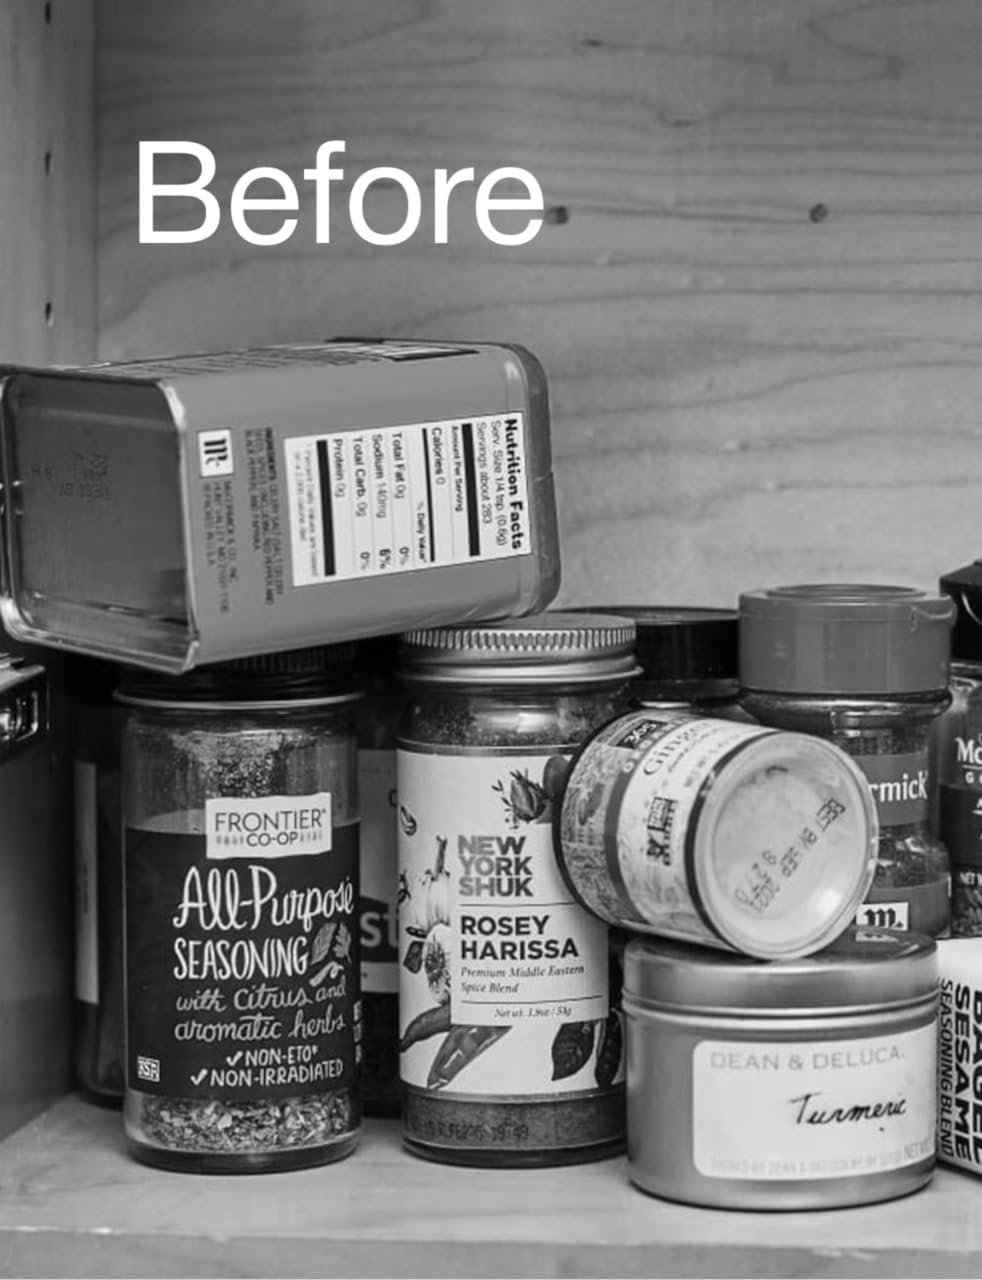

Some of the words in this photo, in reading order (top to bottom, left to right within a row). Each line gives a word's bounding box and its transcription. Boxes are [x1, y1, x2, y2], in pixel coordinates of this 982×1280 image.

[333, 439, 345, 481] Protein
[353, 437, 364, 466] Total
[373, 434, 384, 479] Sodium
[392, 433, 404, 461] Total
[432, 427, 445, 475] Calories
[504, 418, 522, 496] Nutrition
[394, 463, 405, 482] Fat
[510, 501, 524, 550] Facts
[216, 809, 323, 832] FRONTIER
[246, 831, 299, 847] CO-OP
[457, 834, 527, 855] NEW
[458, 856, 533, 876] YORK
[172, 864, 354, 933] All-Purpose
[458, 876, 534, 898] SHUK
[460, 914, 551, 936] ROSEY
[172, 936, 310, 981] SEASONING
[460, 937, 579, 961] HARISSA
[460, 966, 506, 978] Premium
[508, 966, 546, 978] Middle
[547, 965, 585, 976] Eastern
[176, 988, 227, 1012] with
[232, 982, 313, 1011] Citrus
[315, 974, 347, 1003] and
[460, 982, 487, 995] Spice
[489, 982, 520, 993] Blend
[174, 1013, 283, 1042] aromatic
[287, 1003, 347, 1038] herbs
[939, 976, 953, 1091] SEASONING
[210, 1058, 344, 1087] NON-IRRADIATED
[710, 1051, 780, 1071] DEAN
[787, 1054, 804, 1070] &
[954, 982, 972, 1163] SESAME
[789, 1091, 907, 1126] Turmeric
[940, 1092, 953, 1158] BLEND
